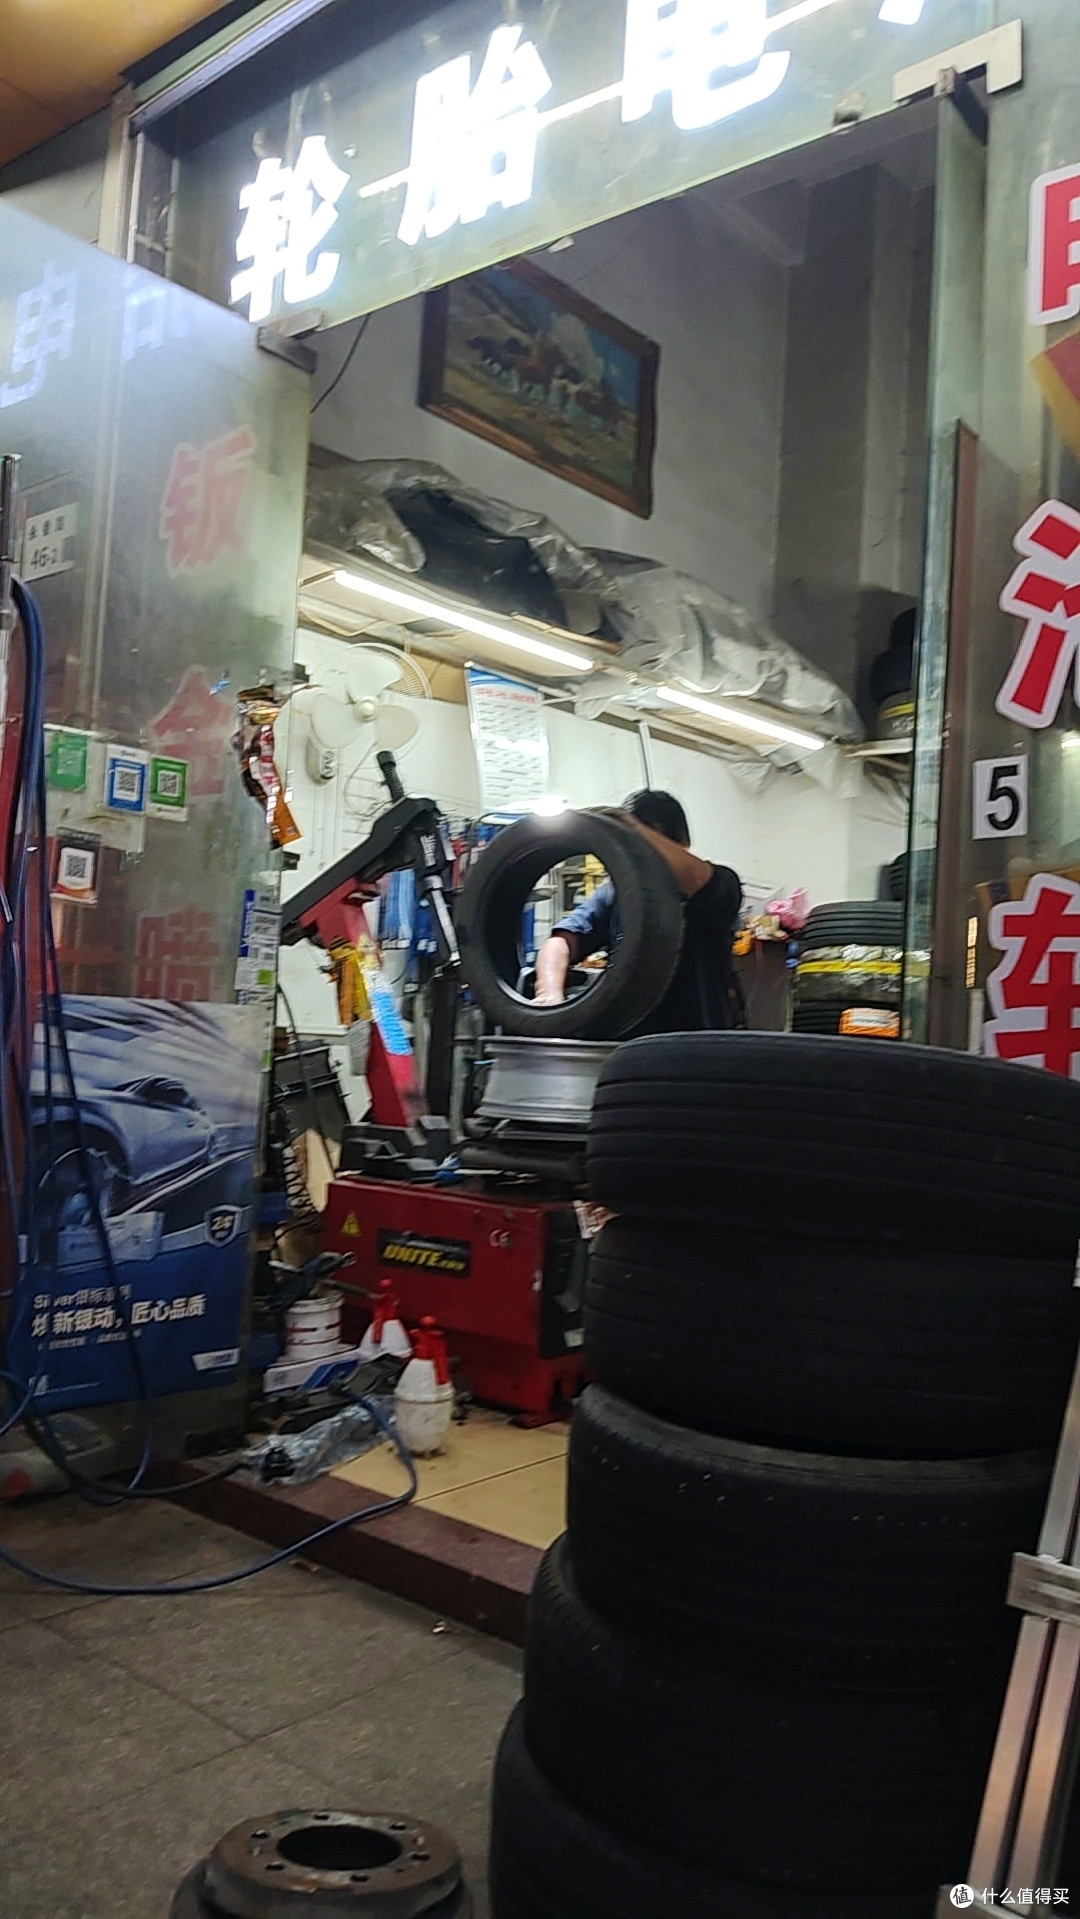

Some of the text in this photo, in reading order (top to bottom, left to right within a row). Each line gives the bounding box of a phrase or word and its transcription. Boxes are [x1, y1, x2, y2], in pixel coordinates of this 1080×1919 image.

[229, 0, 925, 323] 轮胎电
[987, 764, 1021, 832] 5
